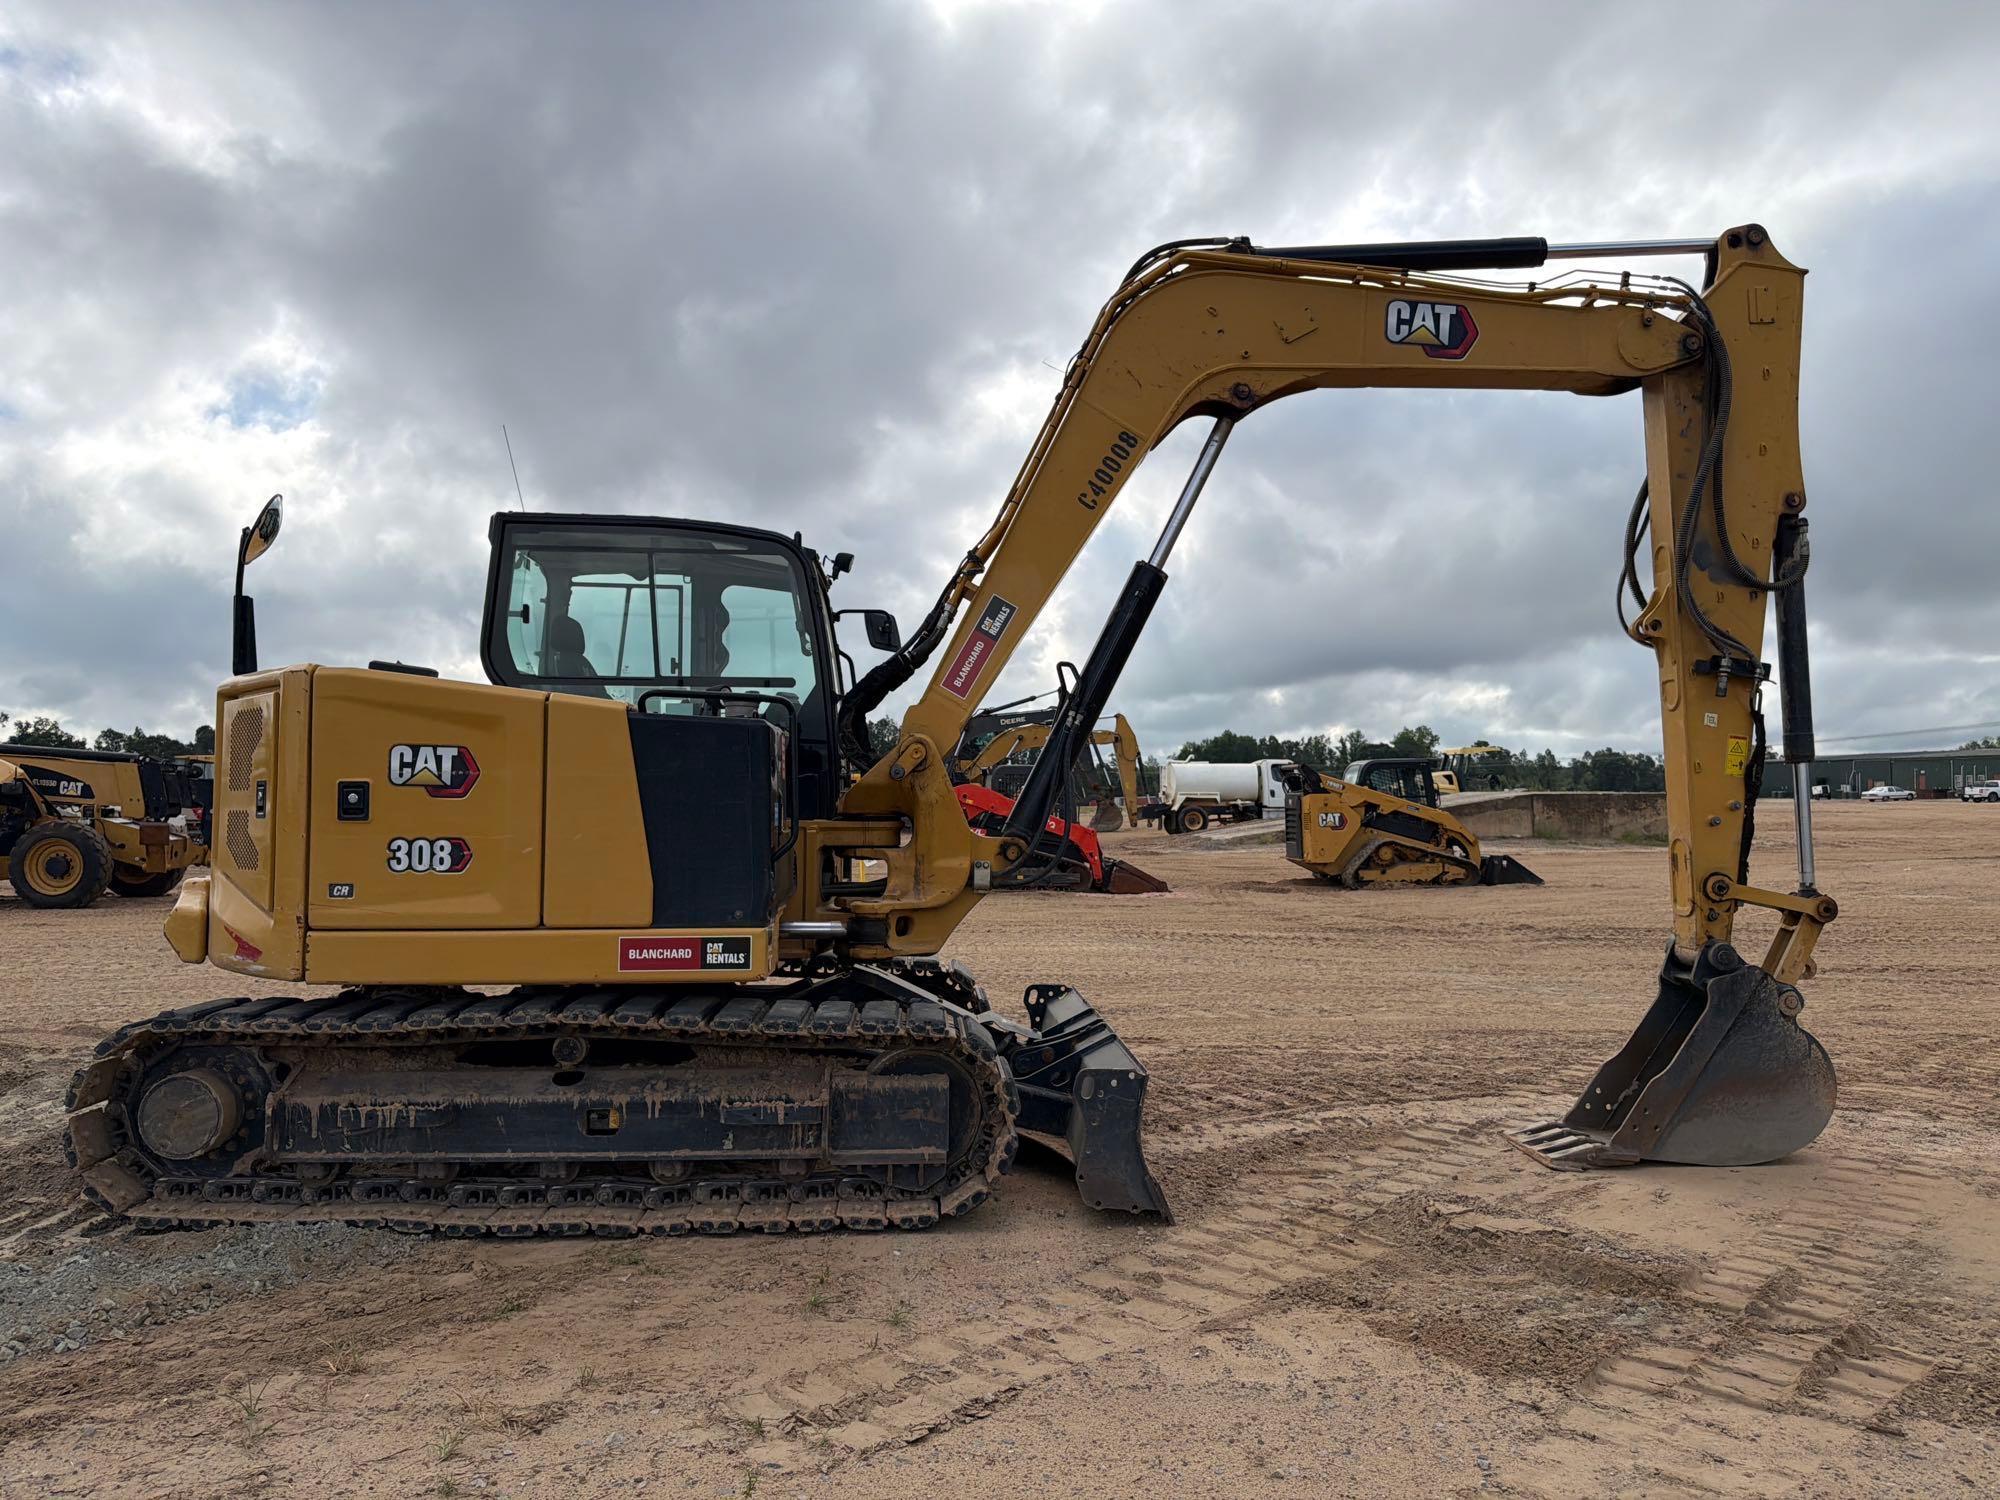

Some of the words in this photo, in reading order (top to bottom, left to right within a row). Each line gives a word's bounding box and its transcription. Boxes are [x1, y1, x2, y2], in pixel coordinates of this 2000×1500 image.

[1387, 300, 1457, 346] CAT
[1077, 431, 1138, 510] C40008
[981, 616, 994, 632] CAT
[989, 606, 1010, 636] RENTALS
[953, 641, 985, 688] BLANCHARD
[1000, 716, 1026, 726] DEERE
[390, 745, 459, 786] CAT
[59, 780, 84, 796] CAT
[1319, 813, 1341, 827] CAT
[389, 839, 452, 871] 308
[333, 885, 350, 896] CR
[628, 949, 692, 959] BLANCHARD
[706, 942, 723, 953] CAT
[706, 953, 745, 964] RENTALS
